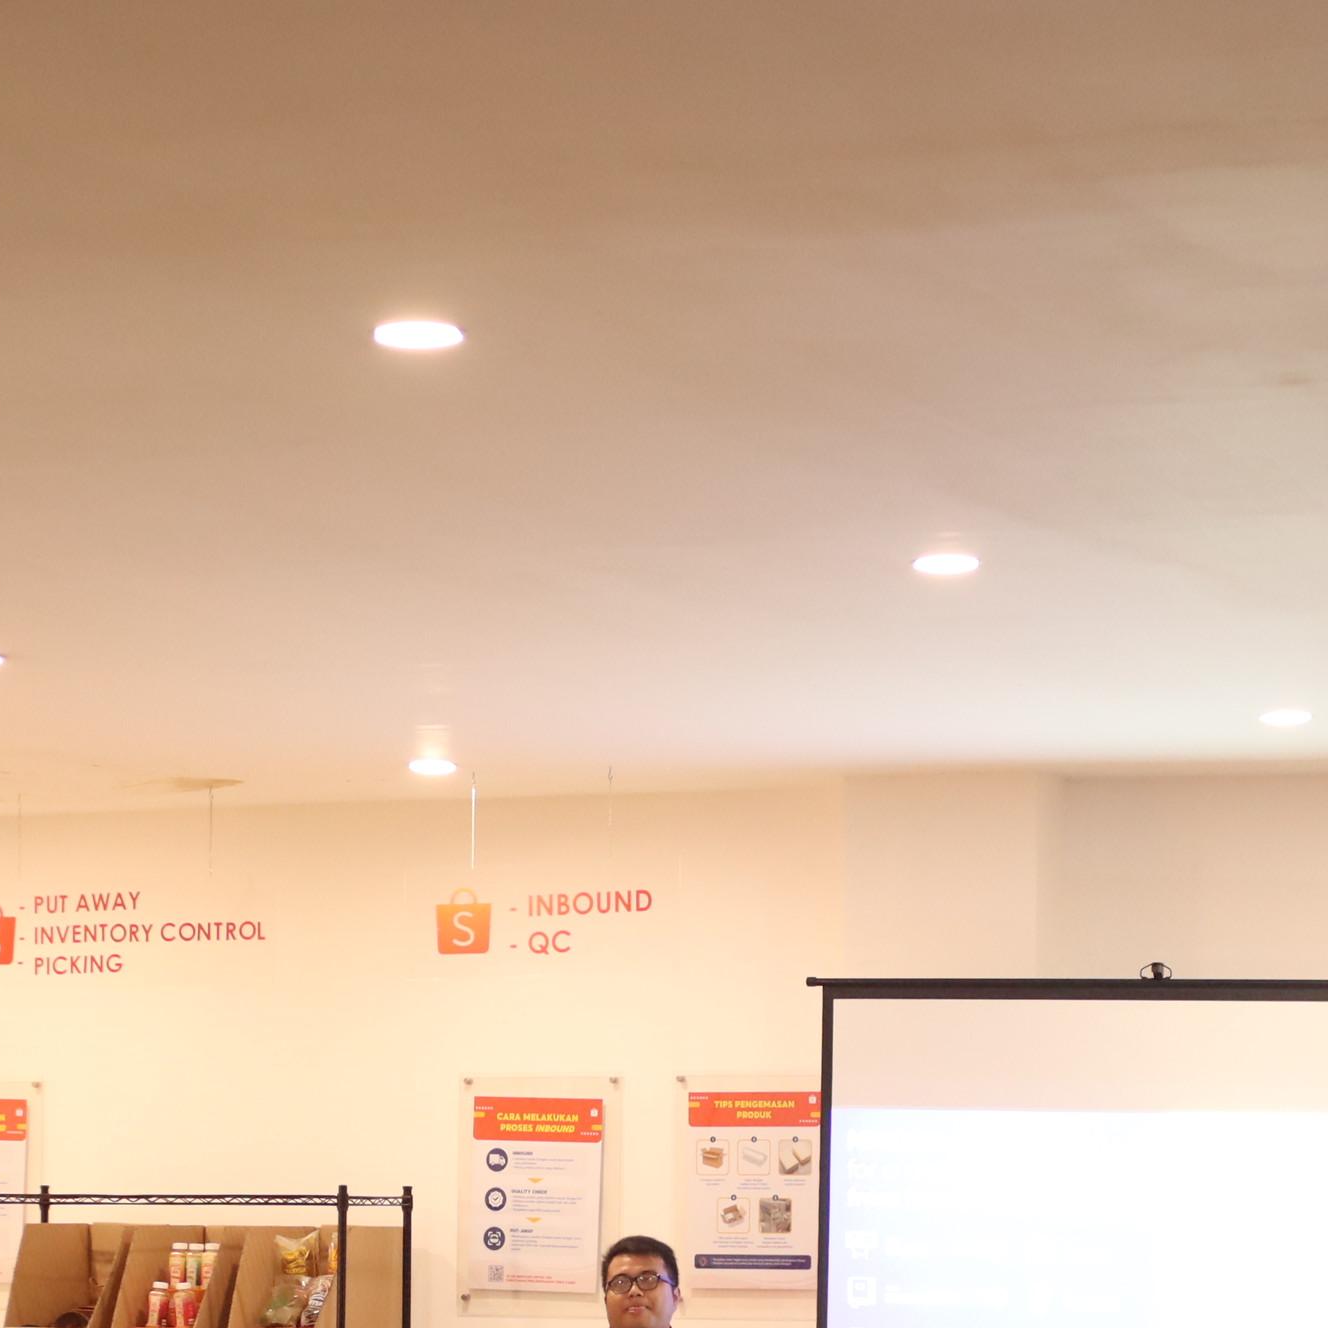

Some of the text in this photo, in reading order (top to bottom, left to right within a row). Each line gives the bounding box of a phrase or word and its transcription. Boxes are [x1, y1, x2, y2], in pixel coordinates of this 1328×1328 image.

[33, 891, 141, 914] PUT AWAY
[528, 889, 653, 917] INBOUND
[34, 920, 267, 945] INVENTORY CONTROL
[528, 930, 572, 956] QC
[34, 953, 124, 975] PICKING
[714, 1100, 795, 1108] TIPS PENGEMASAN
[736, 1111, 772, 1119] PRODUK
[496, 1112, 579, 1122] CARA MELAKUKAN
[500, 1123, 576, 1133] PROSES INBOUND
